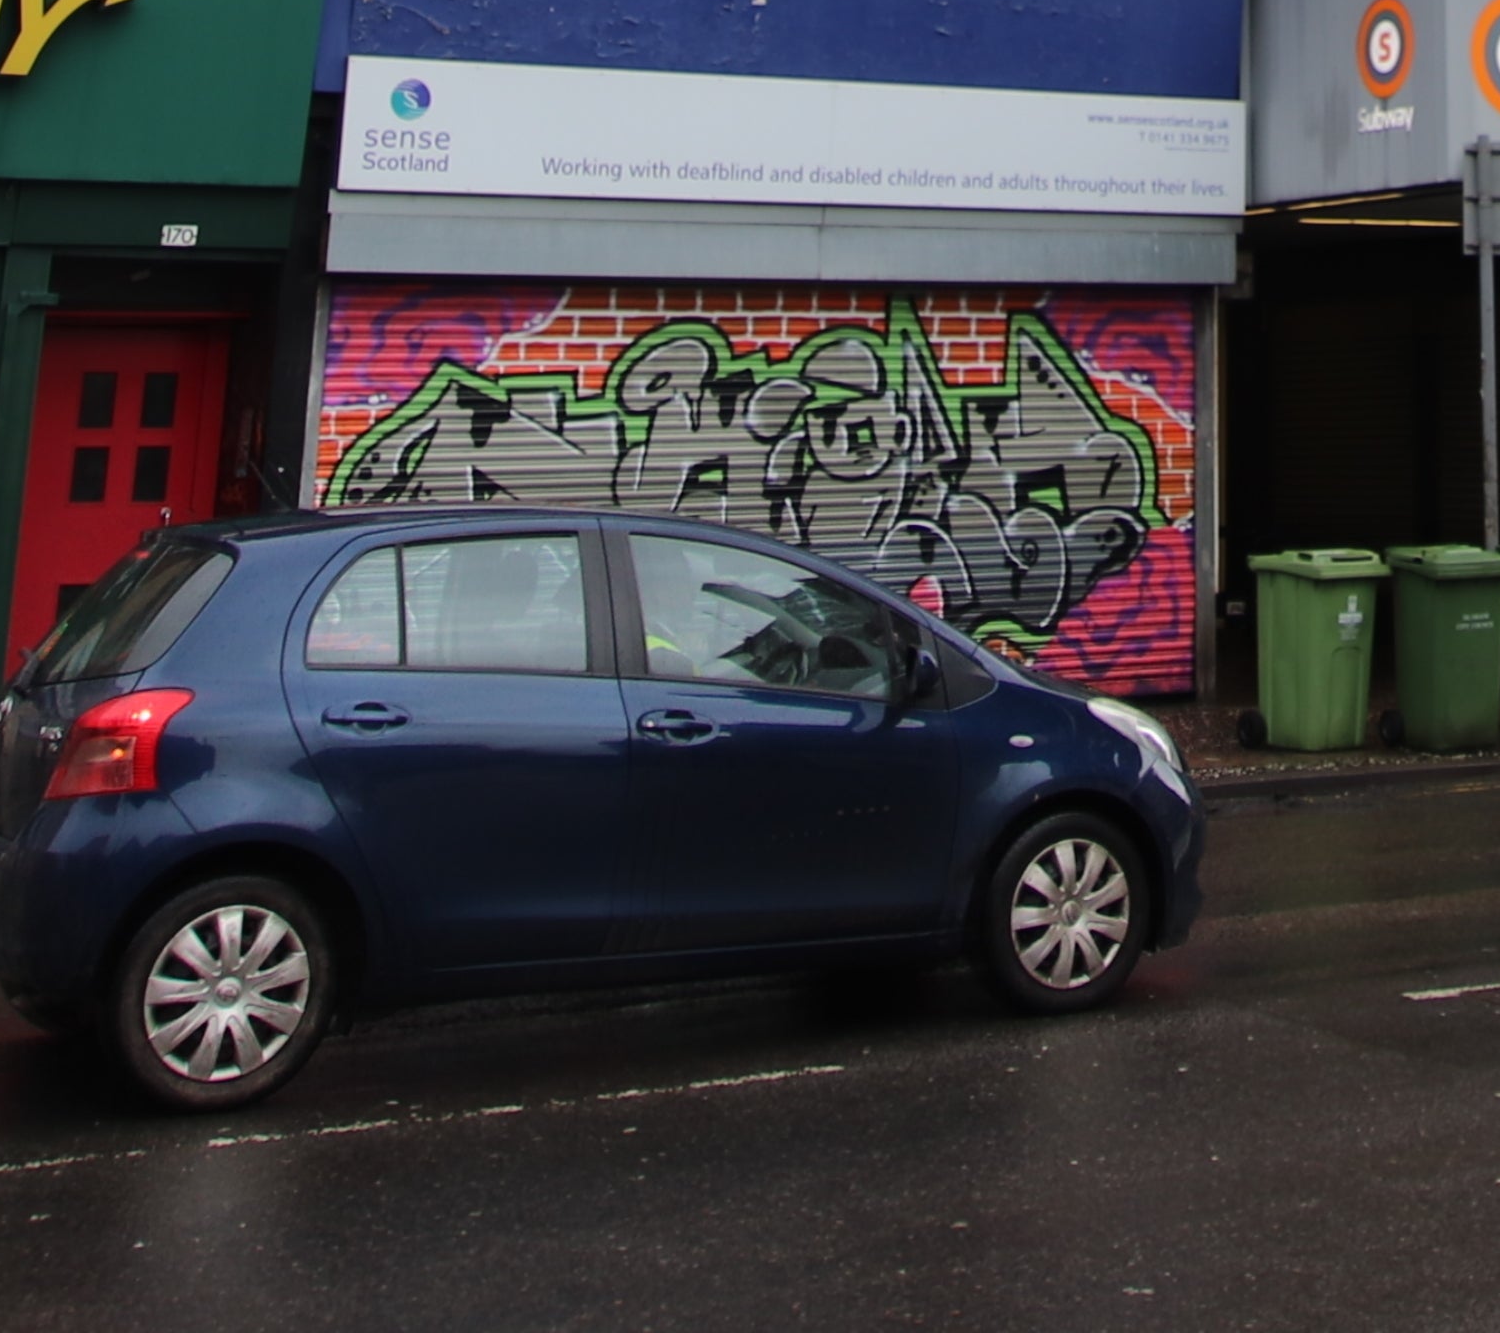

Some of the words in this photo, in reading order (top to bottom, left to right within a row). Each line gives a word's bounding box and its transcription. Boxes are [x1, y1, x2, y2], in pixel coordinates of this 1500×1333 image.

[1357, 105, 1414, 132] Subway
[364, 129, 450, 150] sense
[362, 152, 448, 172] Scotland
[542, 157, 622, 181] Working
[629, 161, 669, 179] with
[677, 163, 763, 182] deafblind
[770, 166, 803, 183] and
[809, 167, 882, 186] disabled
[888, 170, 955, 188] children
[961, 173, 992, 190] and
[999, 174, 1048, 191] adults
[1054, 176, 1146, 197] throughout
[1151, 179, 1186, 196] their
[1192, 180, 1228, 197] lives.
[165, 227, 195, 244] 170
